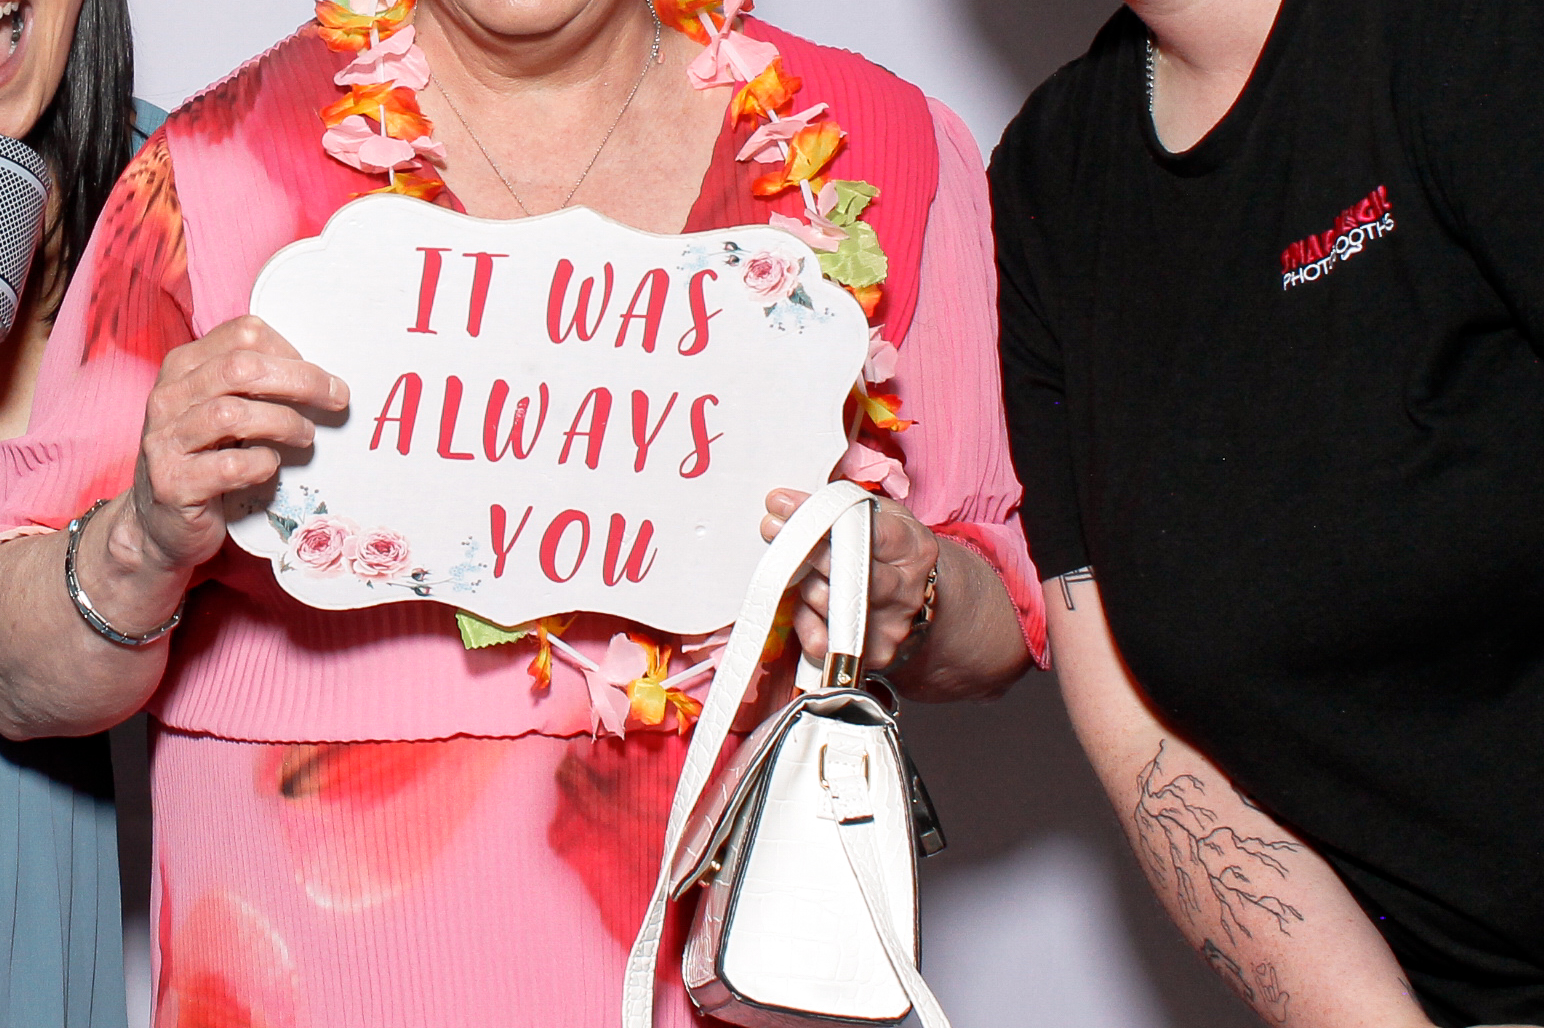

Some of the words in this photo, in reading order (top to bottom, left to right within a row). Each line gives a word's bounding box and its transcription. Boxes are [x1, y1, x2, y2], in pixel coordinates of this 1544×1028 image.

[407, 247, 509, 337] IT
[546, 258, 723, 356] WAS
[369, 372, 724, 478] ALWAYS
[490, 504, 657, 586] YOU
